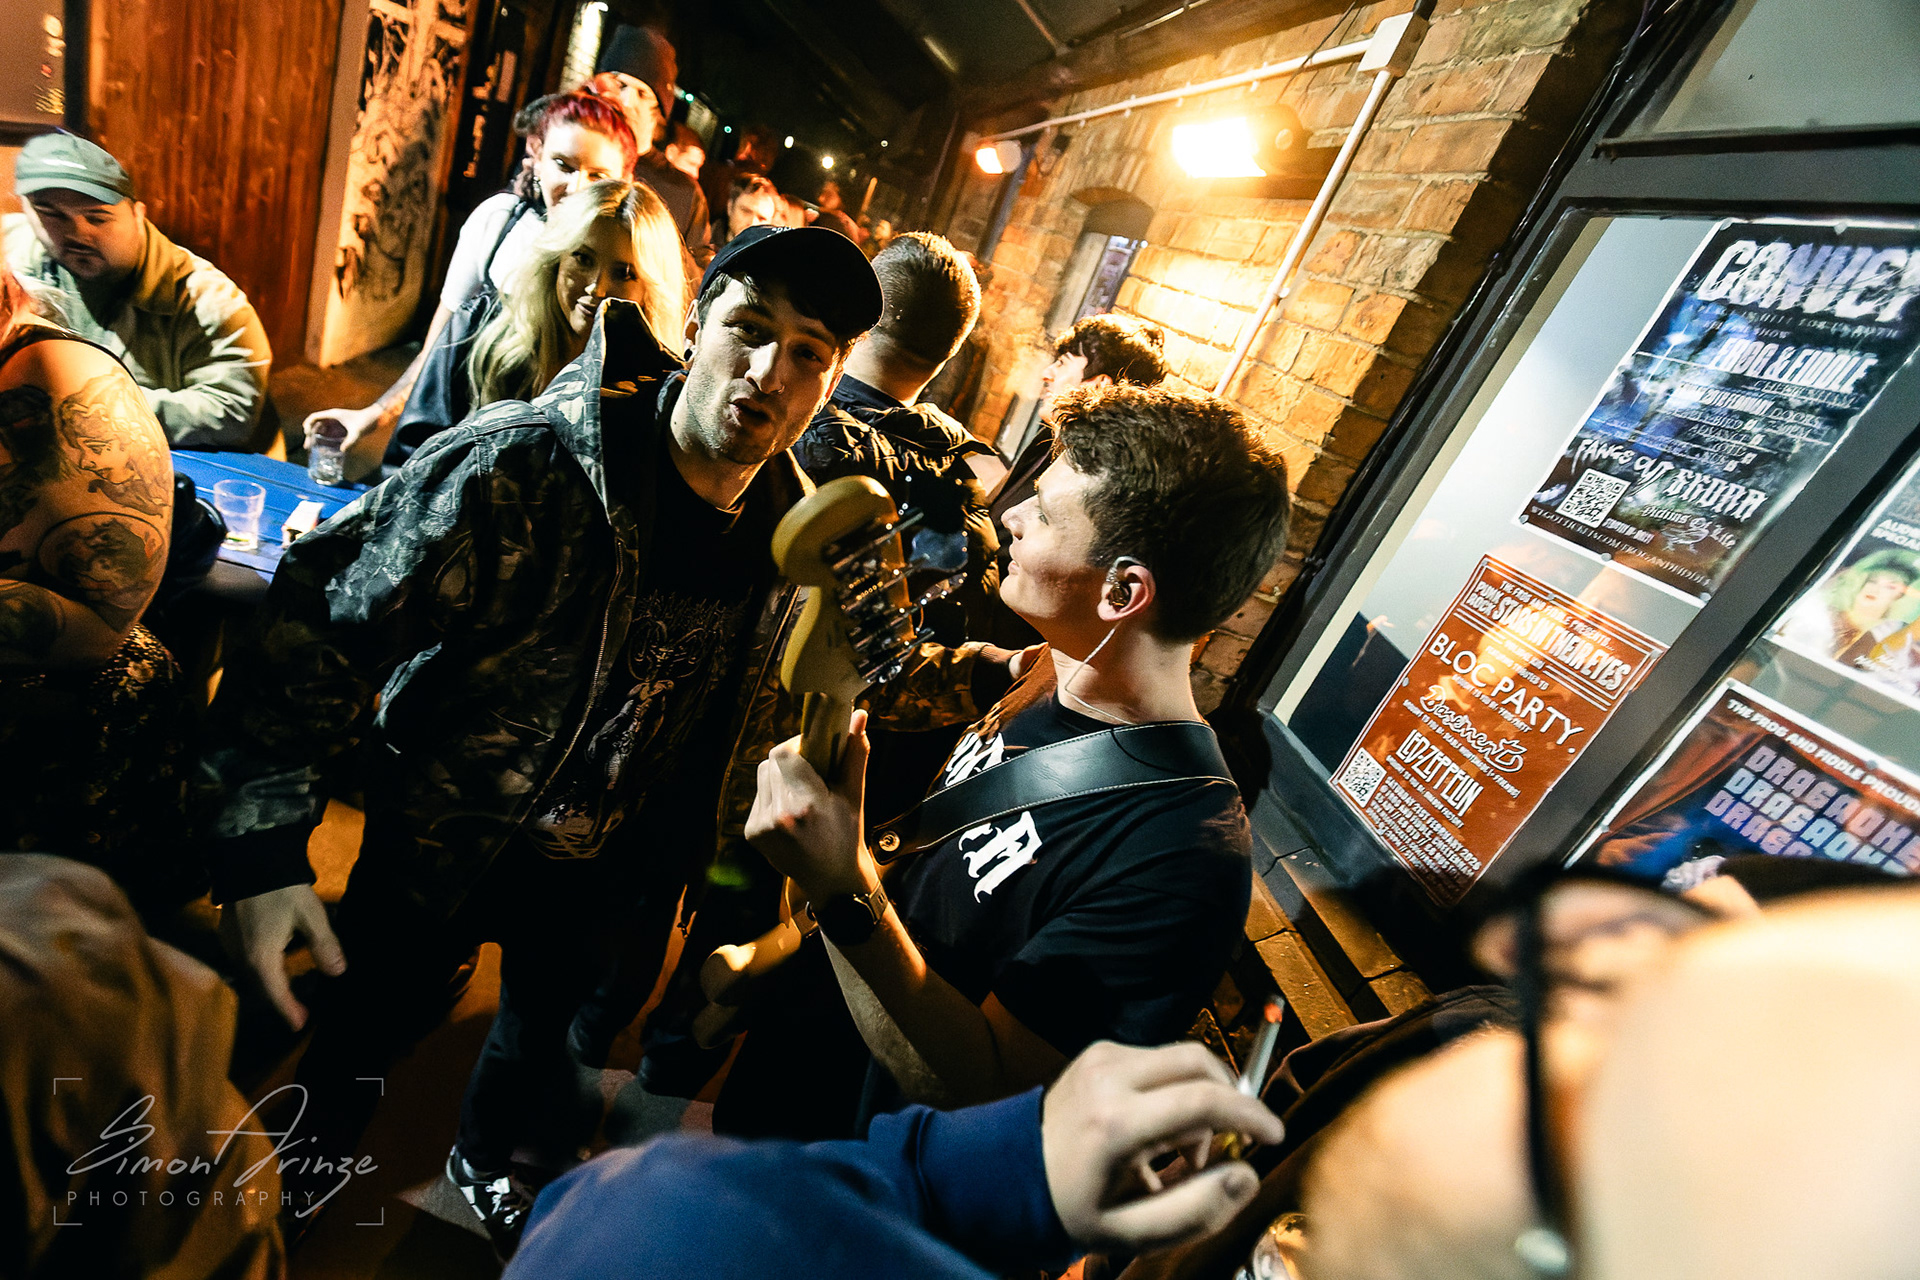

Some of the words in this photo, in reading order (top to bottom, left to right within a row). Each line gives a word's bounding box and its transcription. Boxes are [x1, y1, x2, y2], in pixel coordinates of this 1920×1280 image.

[1706, 337, 1779, 377] FROG
[1762, 346, 1800, 380] &
[1779, 349, 1879, 395] FIDDLE
[1571, 438, 1634, 474] FANGS
[1466, 593, 1496, 615] ROCK
[1473, 580, 1500, 604] PUNK
[1497, 579, 1516, 595] THE
[1510, 586, 1532, 604] FROG
[1527, 596, 1547, 612] AND
[1540, 603, 1573, 627] FIDDLE
[1491, 594, 1543, 638] STARS
[1526, 615, 1556, 646] IN
[1541, 627, 1595, 671] THEIR
[1581, 647, 1632, 692] EYES
[1427, 632, 1496, 688] BLOC
[1490, 676, 1584, 754] PARTY.
[1471, 688, 1483, 698] TO
[1478, 693, 1492, 705] YOU
[1535, 678, 1550, 692] TO
[1420, 712, 1431, 724] TO
[1426, 718, 1440, 731] YOU
[1396, 729, 1484, 818] LED-ZEPPELIN
[1723, 697, 1757, 720] THE
[1747, 710, 1790, 739] FROG
[1783, 730, 1817, 754] AND
[1811, 746, 1866, 781] FIDDLE
[1860, 774, 1920, 819] PROUD
[1401, 769, 1413, 781] TO
[1407, 774, 1420, 788] YOU
[1439, 805, 1465, 830] FACTORY
[1382, 774, 1418, 809] SATURDAY
[1409, 800, 1432, 823] 21ST
[1424, 814, 1466, 854] FEBRUARY
[1457, 846, 1484, 872] 2026
[1383, 788, 1403, 809] FROG
[1396, 801, 1414, 820] AND
[1428, 834, 1476, 880] CHELTENHAM
